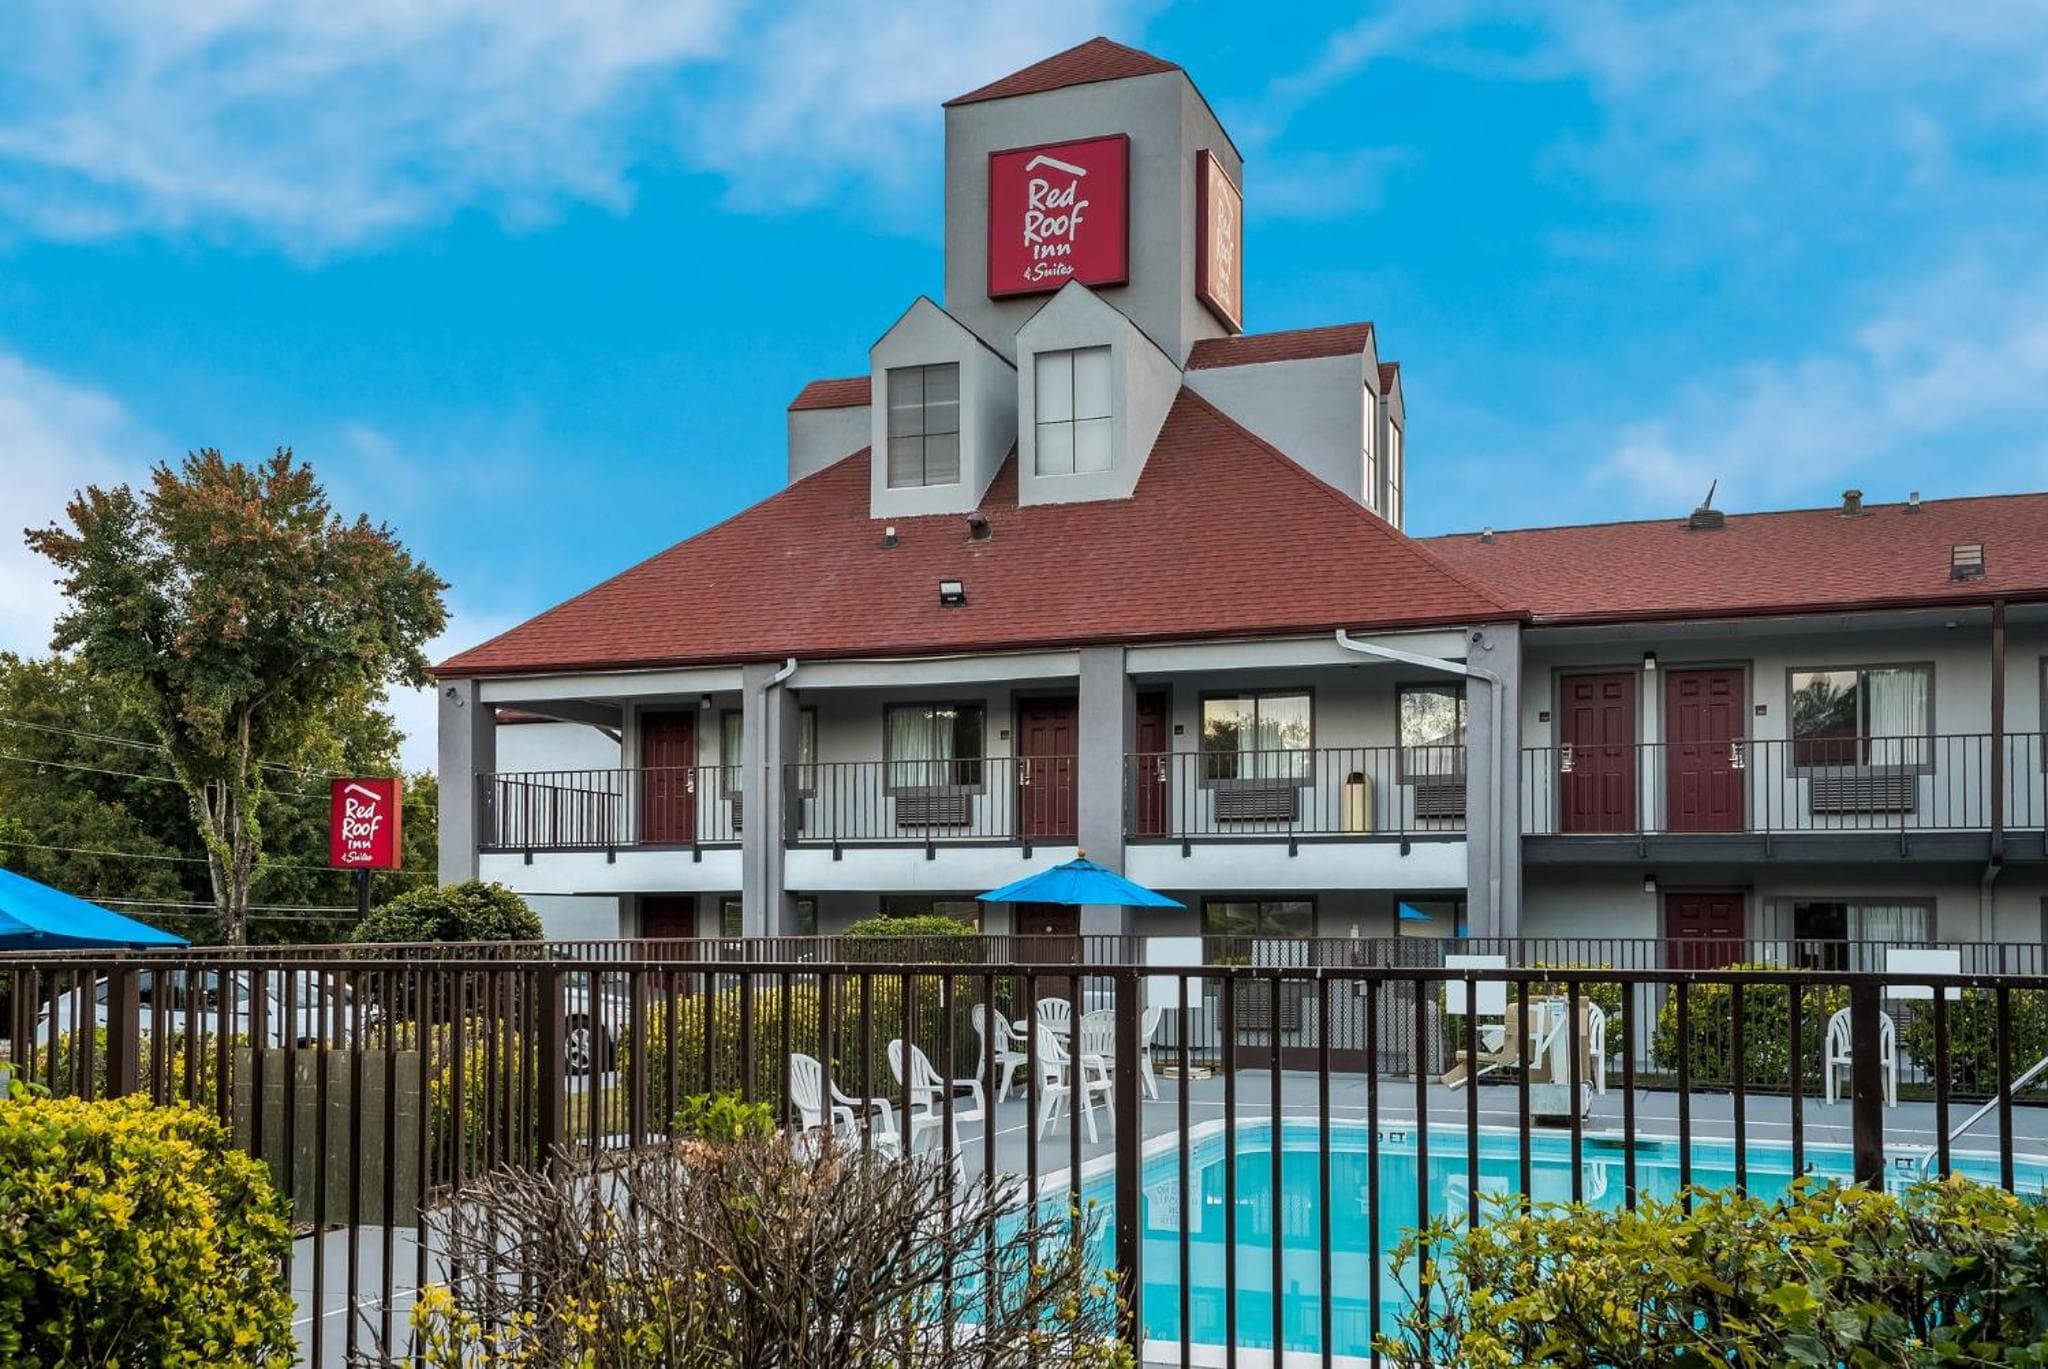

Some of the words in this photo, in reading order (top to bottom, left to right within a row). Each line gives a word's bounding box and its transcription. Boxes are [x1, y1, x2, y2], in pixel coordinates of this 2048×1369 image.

[1028, 178, 1078, 211] Red
[1023, 200, 1089, 247] Roof
[345, 798, 376, 820] Red
[342, 815, 383, 841] Roof
